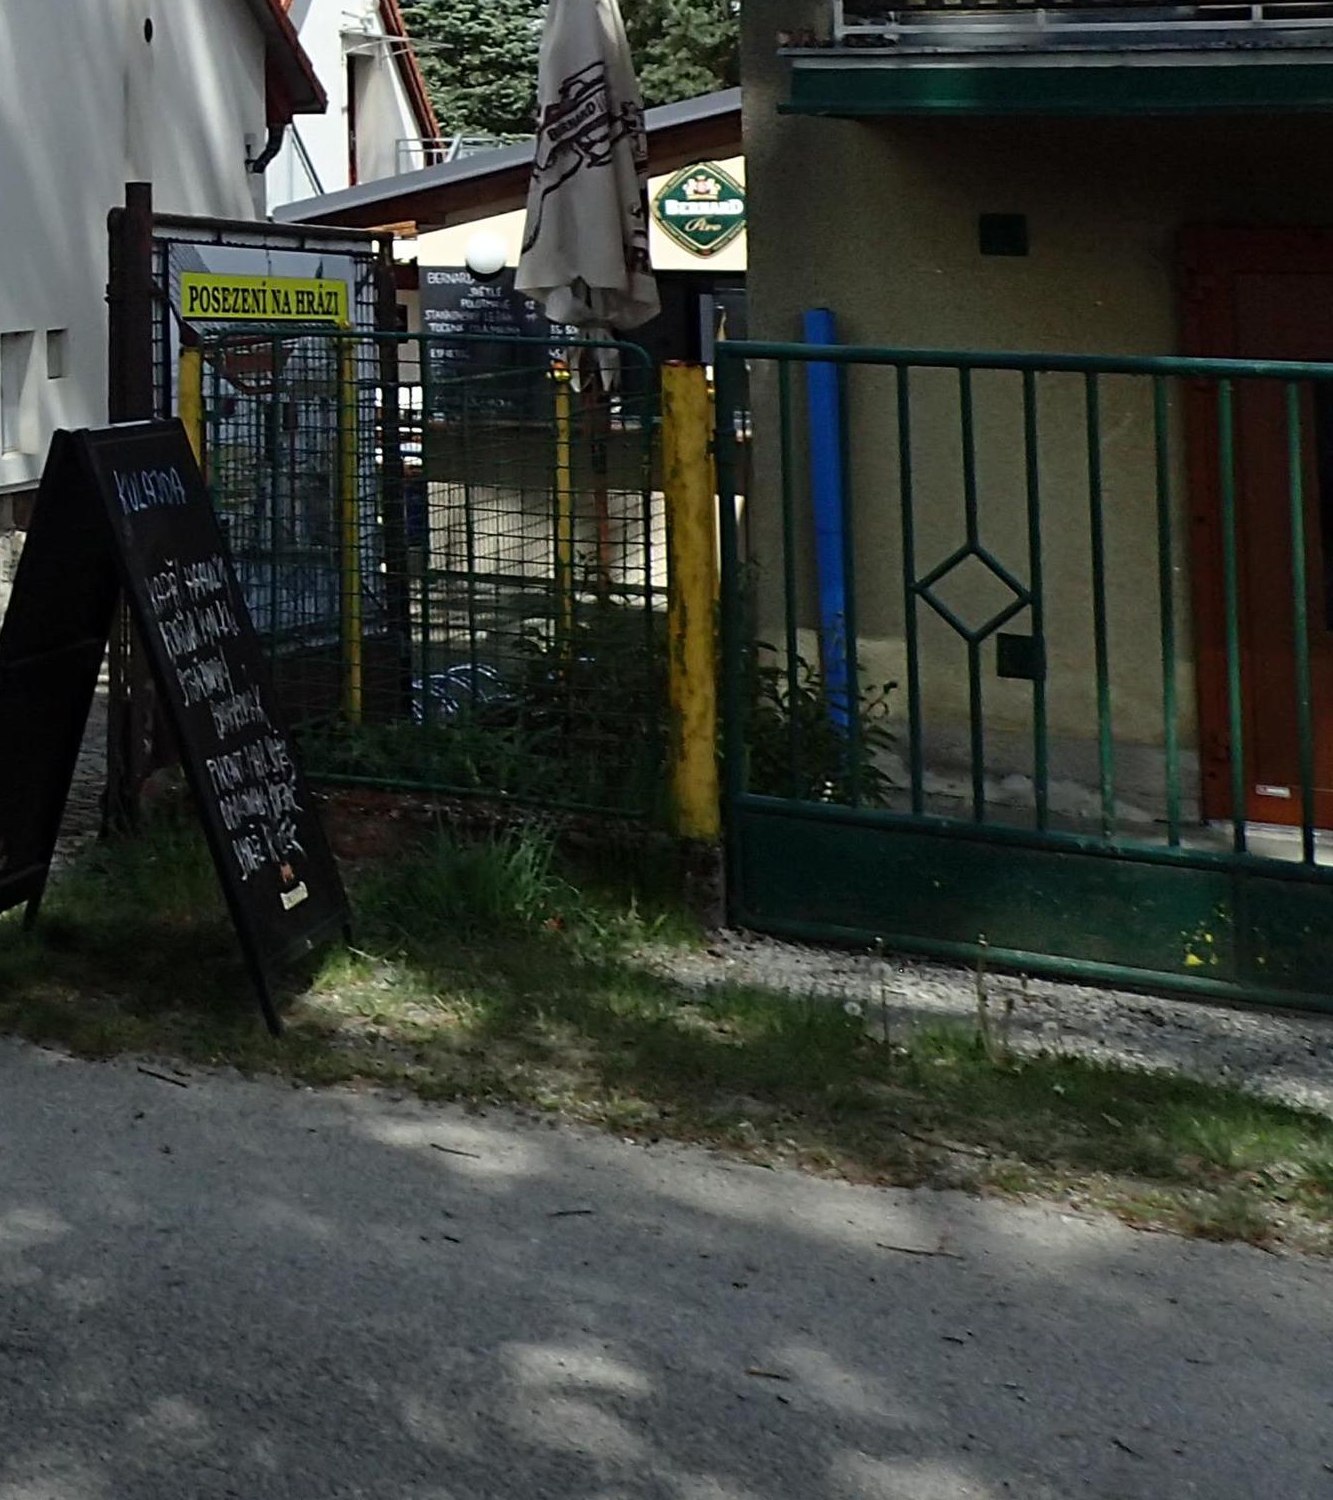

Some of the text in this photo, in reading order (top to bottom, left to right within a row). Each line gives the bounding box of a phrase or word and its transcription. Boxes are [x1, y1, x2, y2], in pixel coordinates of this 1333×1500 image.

[188, 280, 340, 316] POSEZENÍ NA HRÁZI
